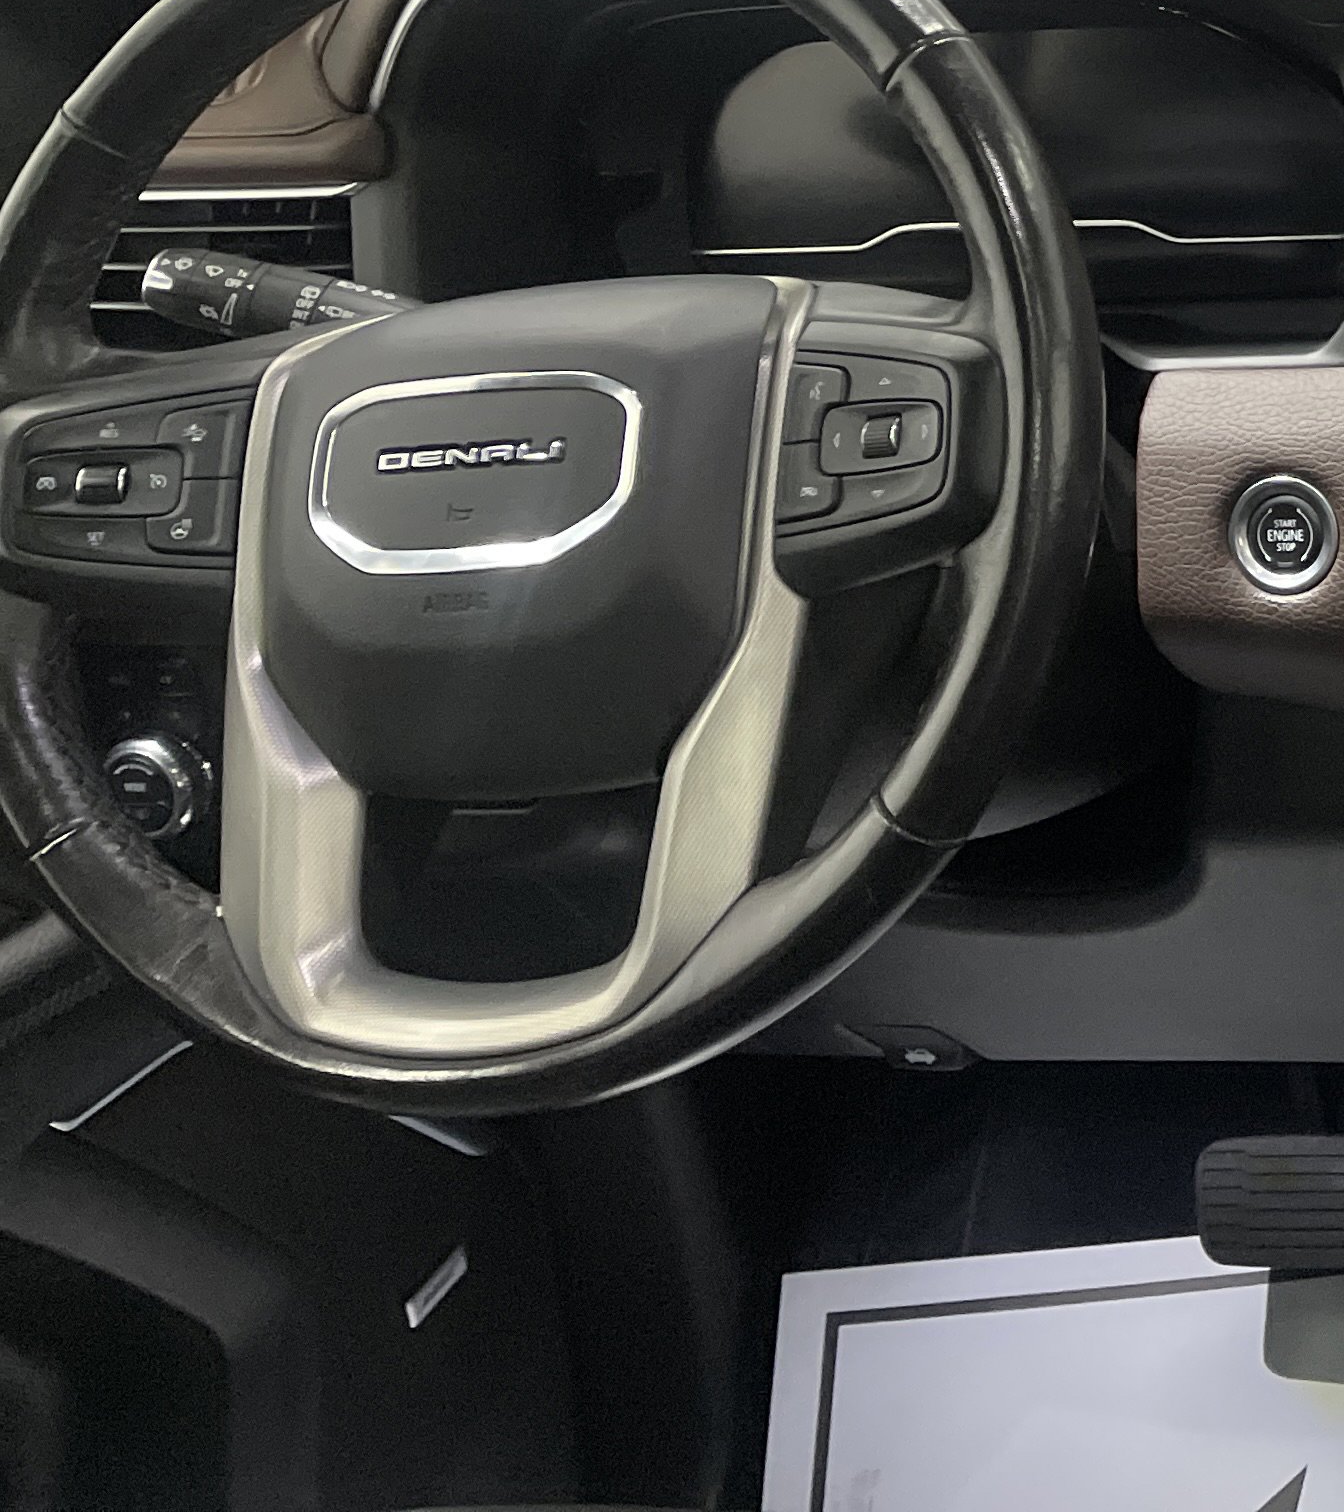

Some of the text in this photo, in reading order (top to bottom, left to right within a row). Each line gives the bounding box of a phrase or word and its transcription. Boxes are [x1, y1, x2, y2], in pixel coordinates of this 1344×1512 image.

[377, 439, 563, 471] DENALI
[1273, 519, 1297, 528] START
[1266, 529, 1305, 542] ENGINE
[1276, 542, 1297, 552] STOP
